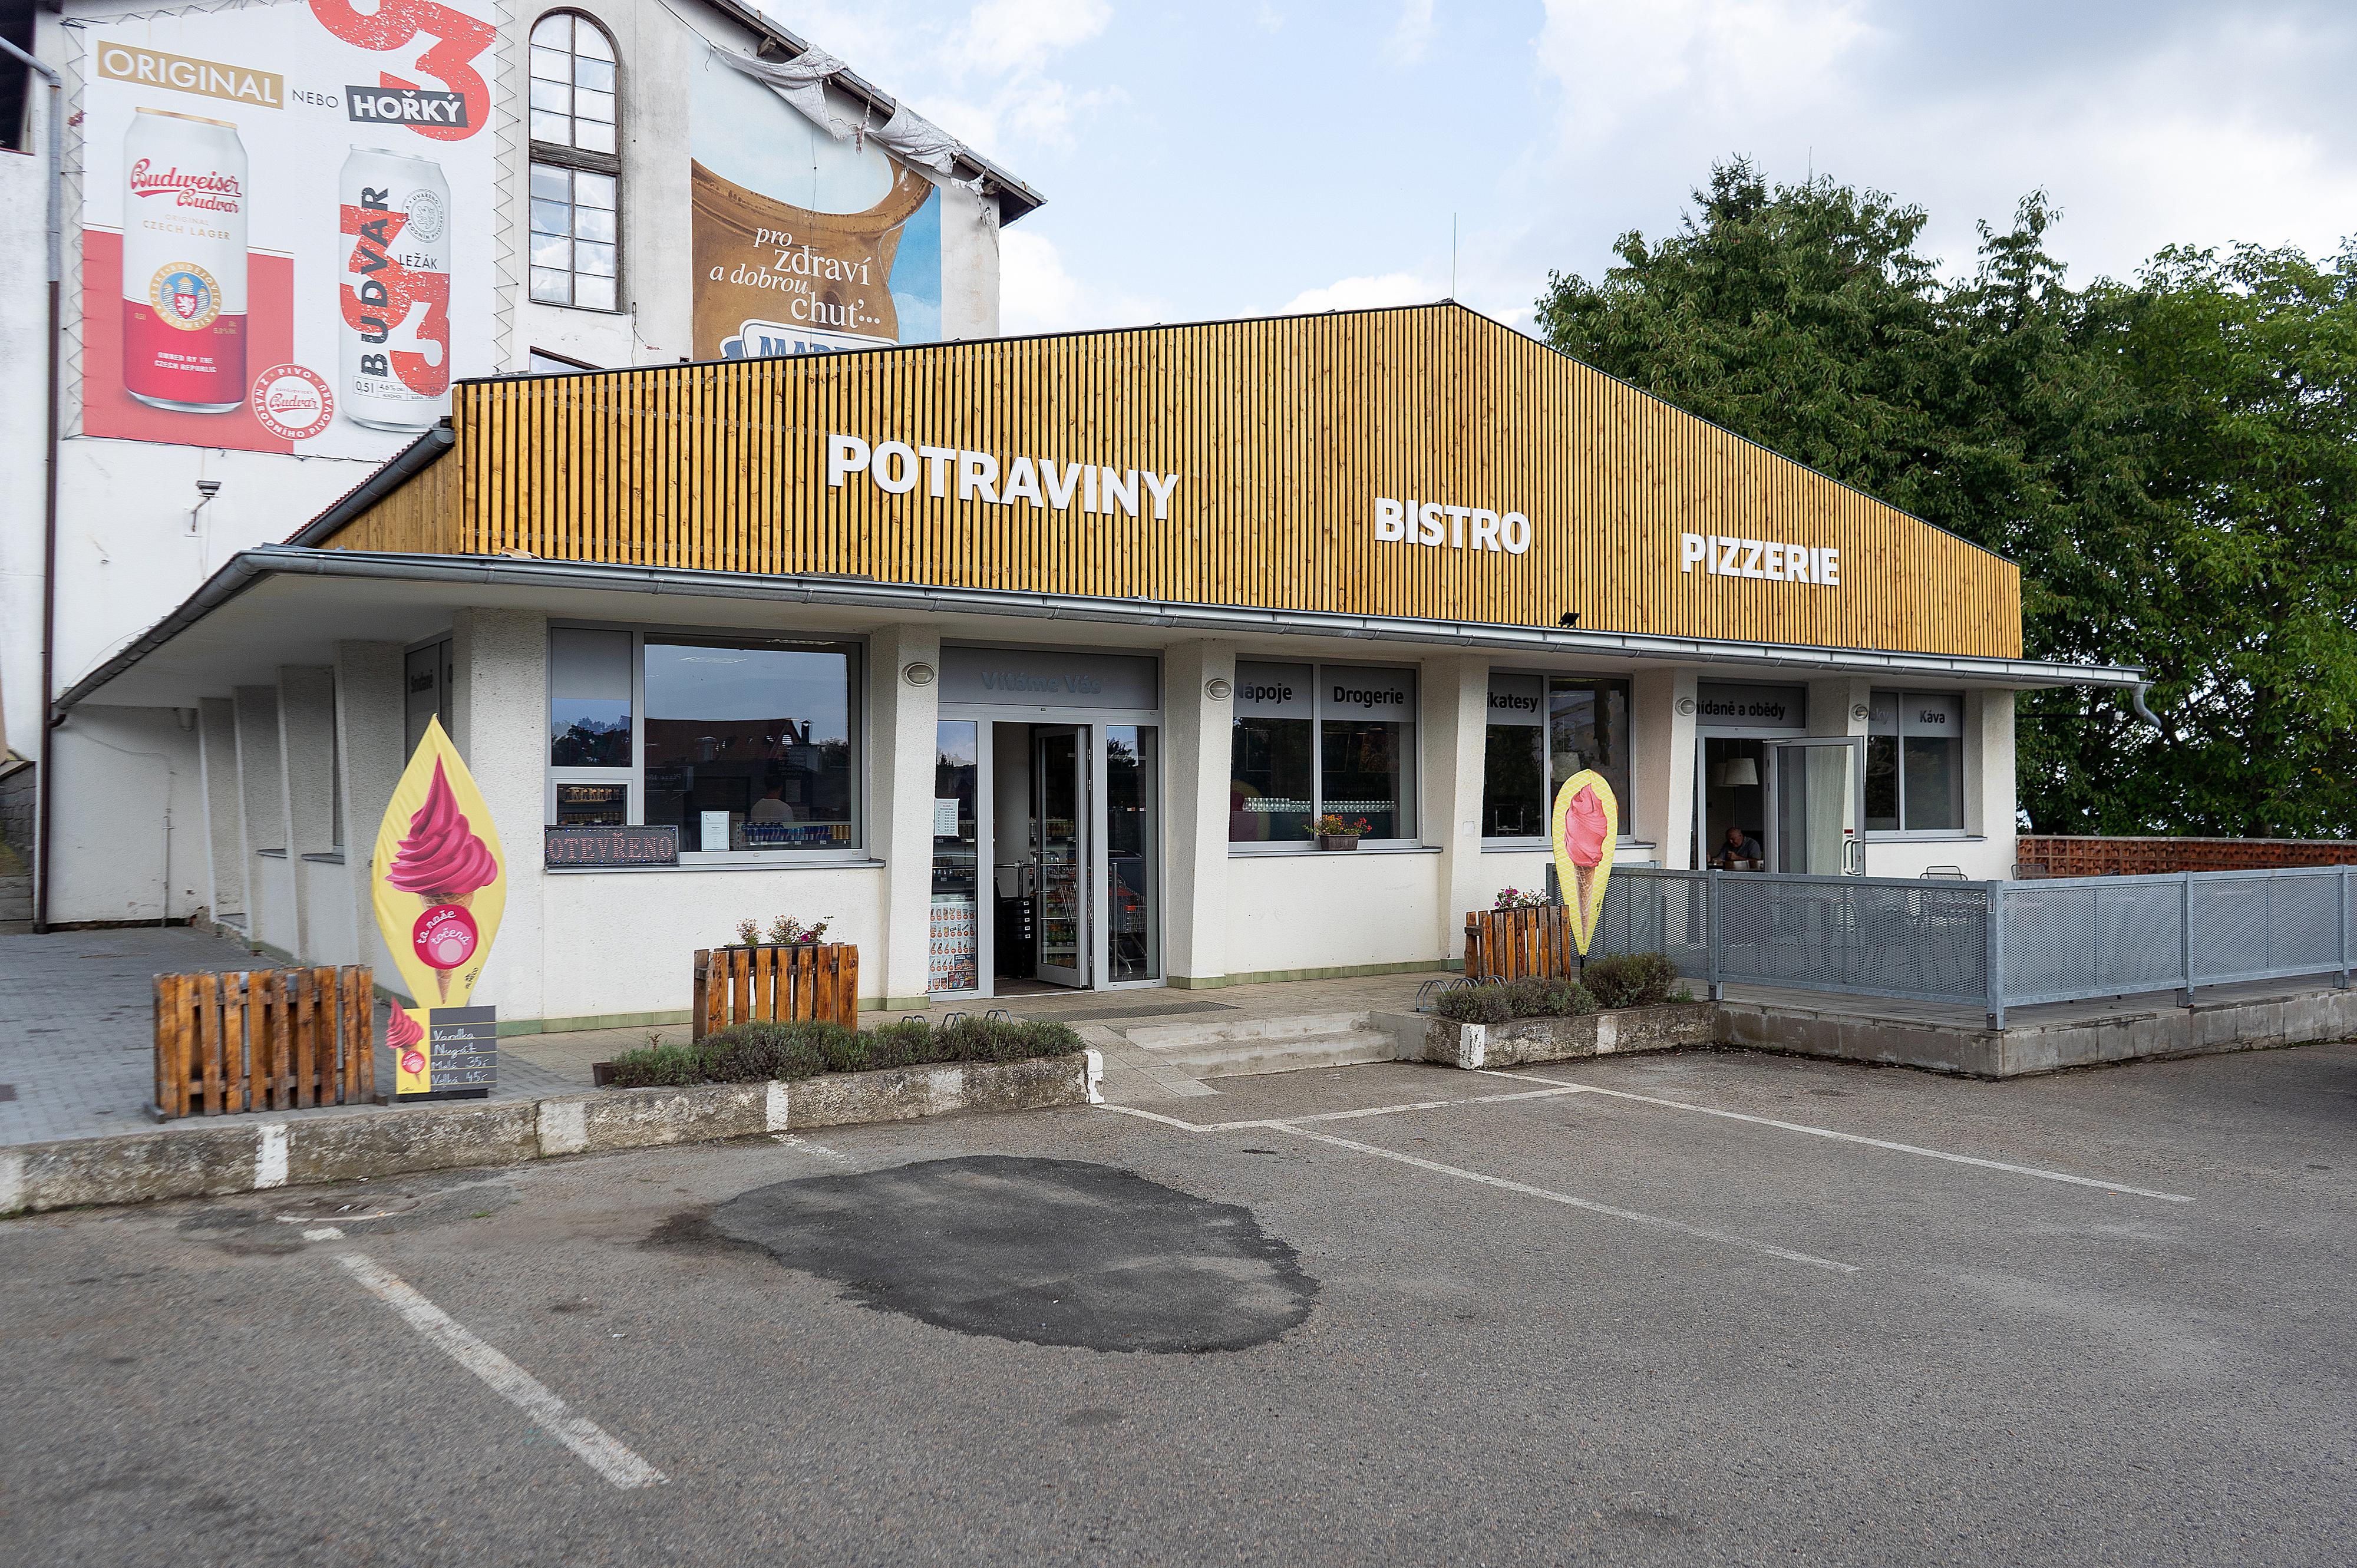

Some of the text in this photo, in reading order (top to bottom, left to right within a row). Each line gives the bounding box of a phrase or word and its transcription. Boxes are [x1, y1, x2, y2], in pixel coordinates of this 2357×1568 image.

[104, 48, 461, 123] ORIGINAL NEBO HOŘKÝ
[130, 158, 242, 195] Budweiser
[176, 188, 239, 213] Budvar
[143, 220, 231, 240] CZECH LAGER
[753, 227, 793, 247] pro
[399, 252, 438, 269] LEŽÁK
[774, 245, 871, 286] zdraví
[361, 187, 388, 377] BUDVAR
[709, 263, 808, 294] a dobrou
[277, 367, 312, 378] PIVO
[270, 393, 319, 410] Budvar
[828, 433, 1180, 520] POTRAVINY
[1375, 497, 1531, 554] BISTRO
[1681, 533, 1840, 586] PIZZERIE
[1065, 674, 1101, 695] Vás
[1333, 685, 1405, 708] Drogerie
[1738, 705, 1745, 716] a
[1749, 702, 1786, 721] obědy
[1920, 709, 1945, 724] Káva
[548, 832, 674, 859] OTEVŘENO
[426, 909, 457, 929] naše
[430, 927, 472, 946] točená
